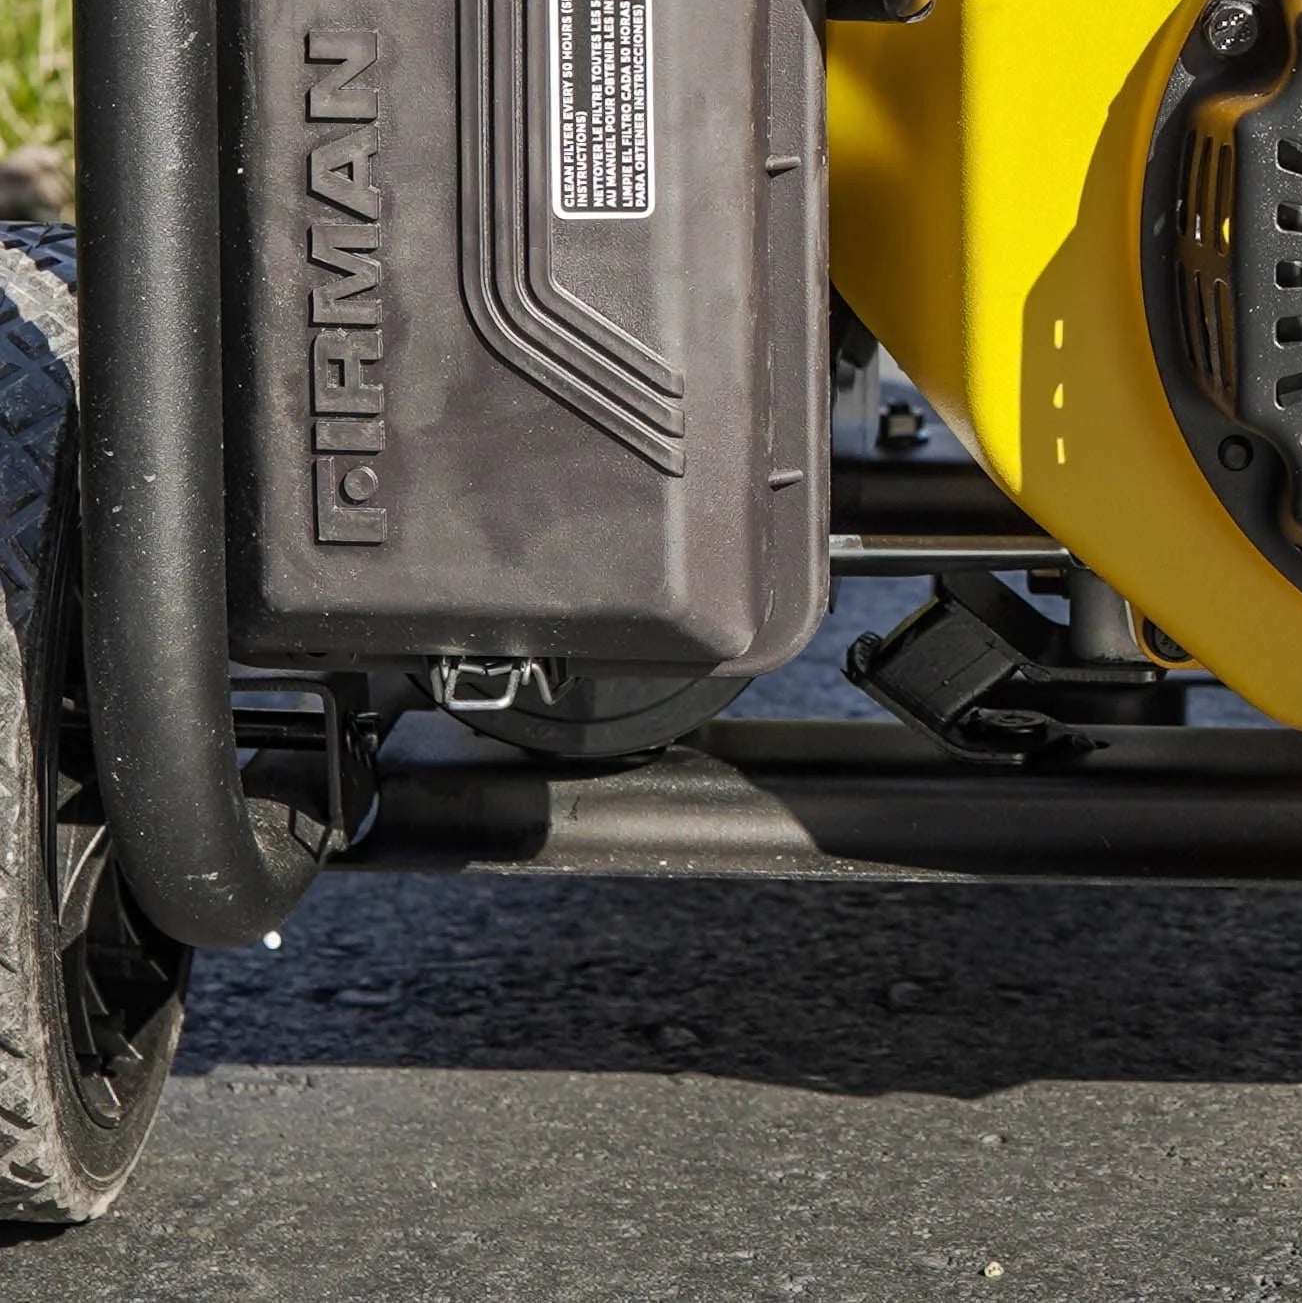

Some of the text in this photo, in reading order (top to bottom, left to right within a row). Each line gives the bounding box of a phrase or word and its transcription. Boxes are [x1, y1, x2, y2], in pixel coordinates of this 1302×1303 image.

[561, 16, 572, 59] HOURS
[591, 10, 601, 31] LES
[603, 17, 614, 38] LES
[620, 1, 631, 44] HORAS
[562, 63, 573, 78] 50
[591, 34, 602, 82] TOUTES
[604, 42, 615, 95] OBTENIR
[620, 47, 631, 63] 50
[562, 80, 573, 119] EVERY
[620, 65, 631, 101] CADA
[592, 85, 603, 124] FILTRE
[605, 98, 616, 132] POUR
[621, 103, 632, 146] FILTRO
[632, 5, 646, 207] PARA OBTENER INSTRUCCIONES)
[563, 123, 574, 163] FILTER
[592, 127, 603, 141] LE
[576, 111, 589, 207] INSTRUCTIONS)
[592, 144, 604, 207] NETTOYER
[605, 135, 616, 187] MANUEL
[622, 148, 632, 163] EL
[563, 166, 574, 207] CLEAN
[606, 190, 617, 207] AU
[622, 166, 633, 207] LIMPIE
[304, 29, 387, 547] FIRMAN
